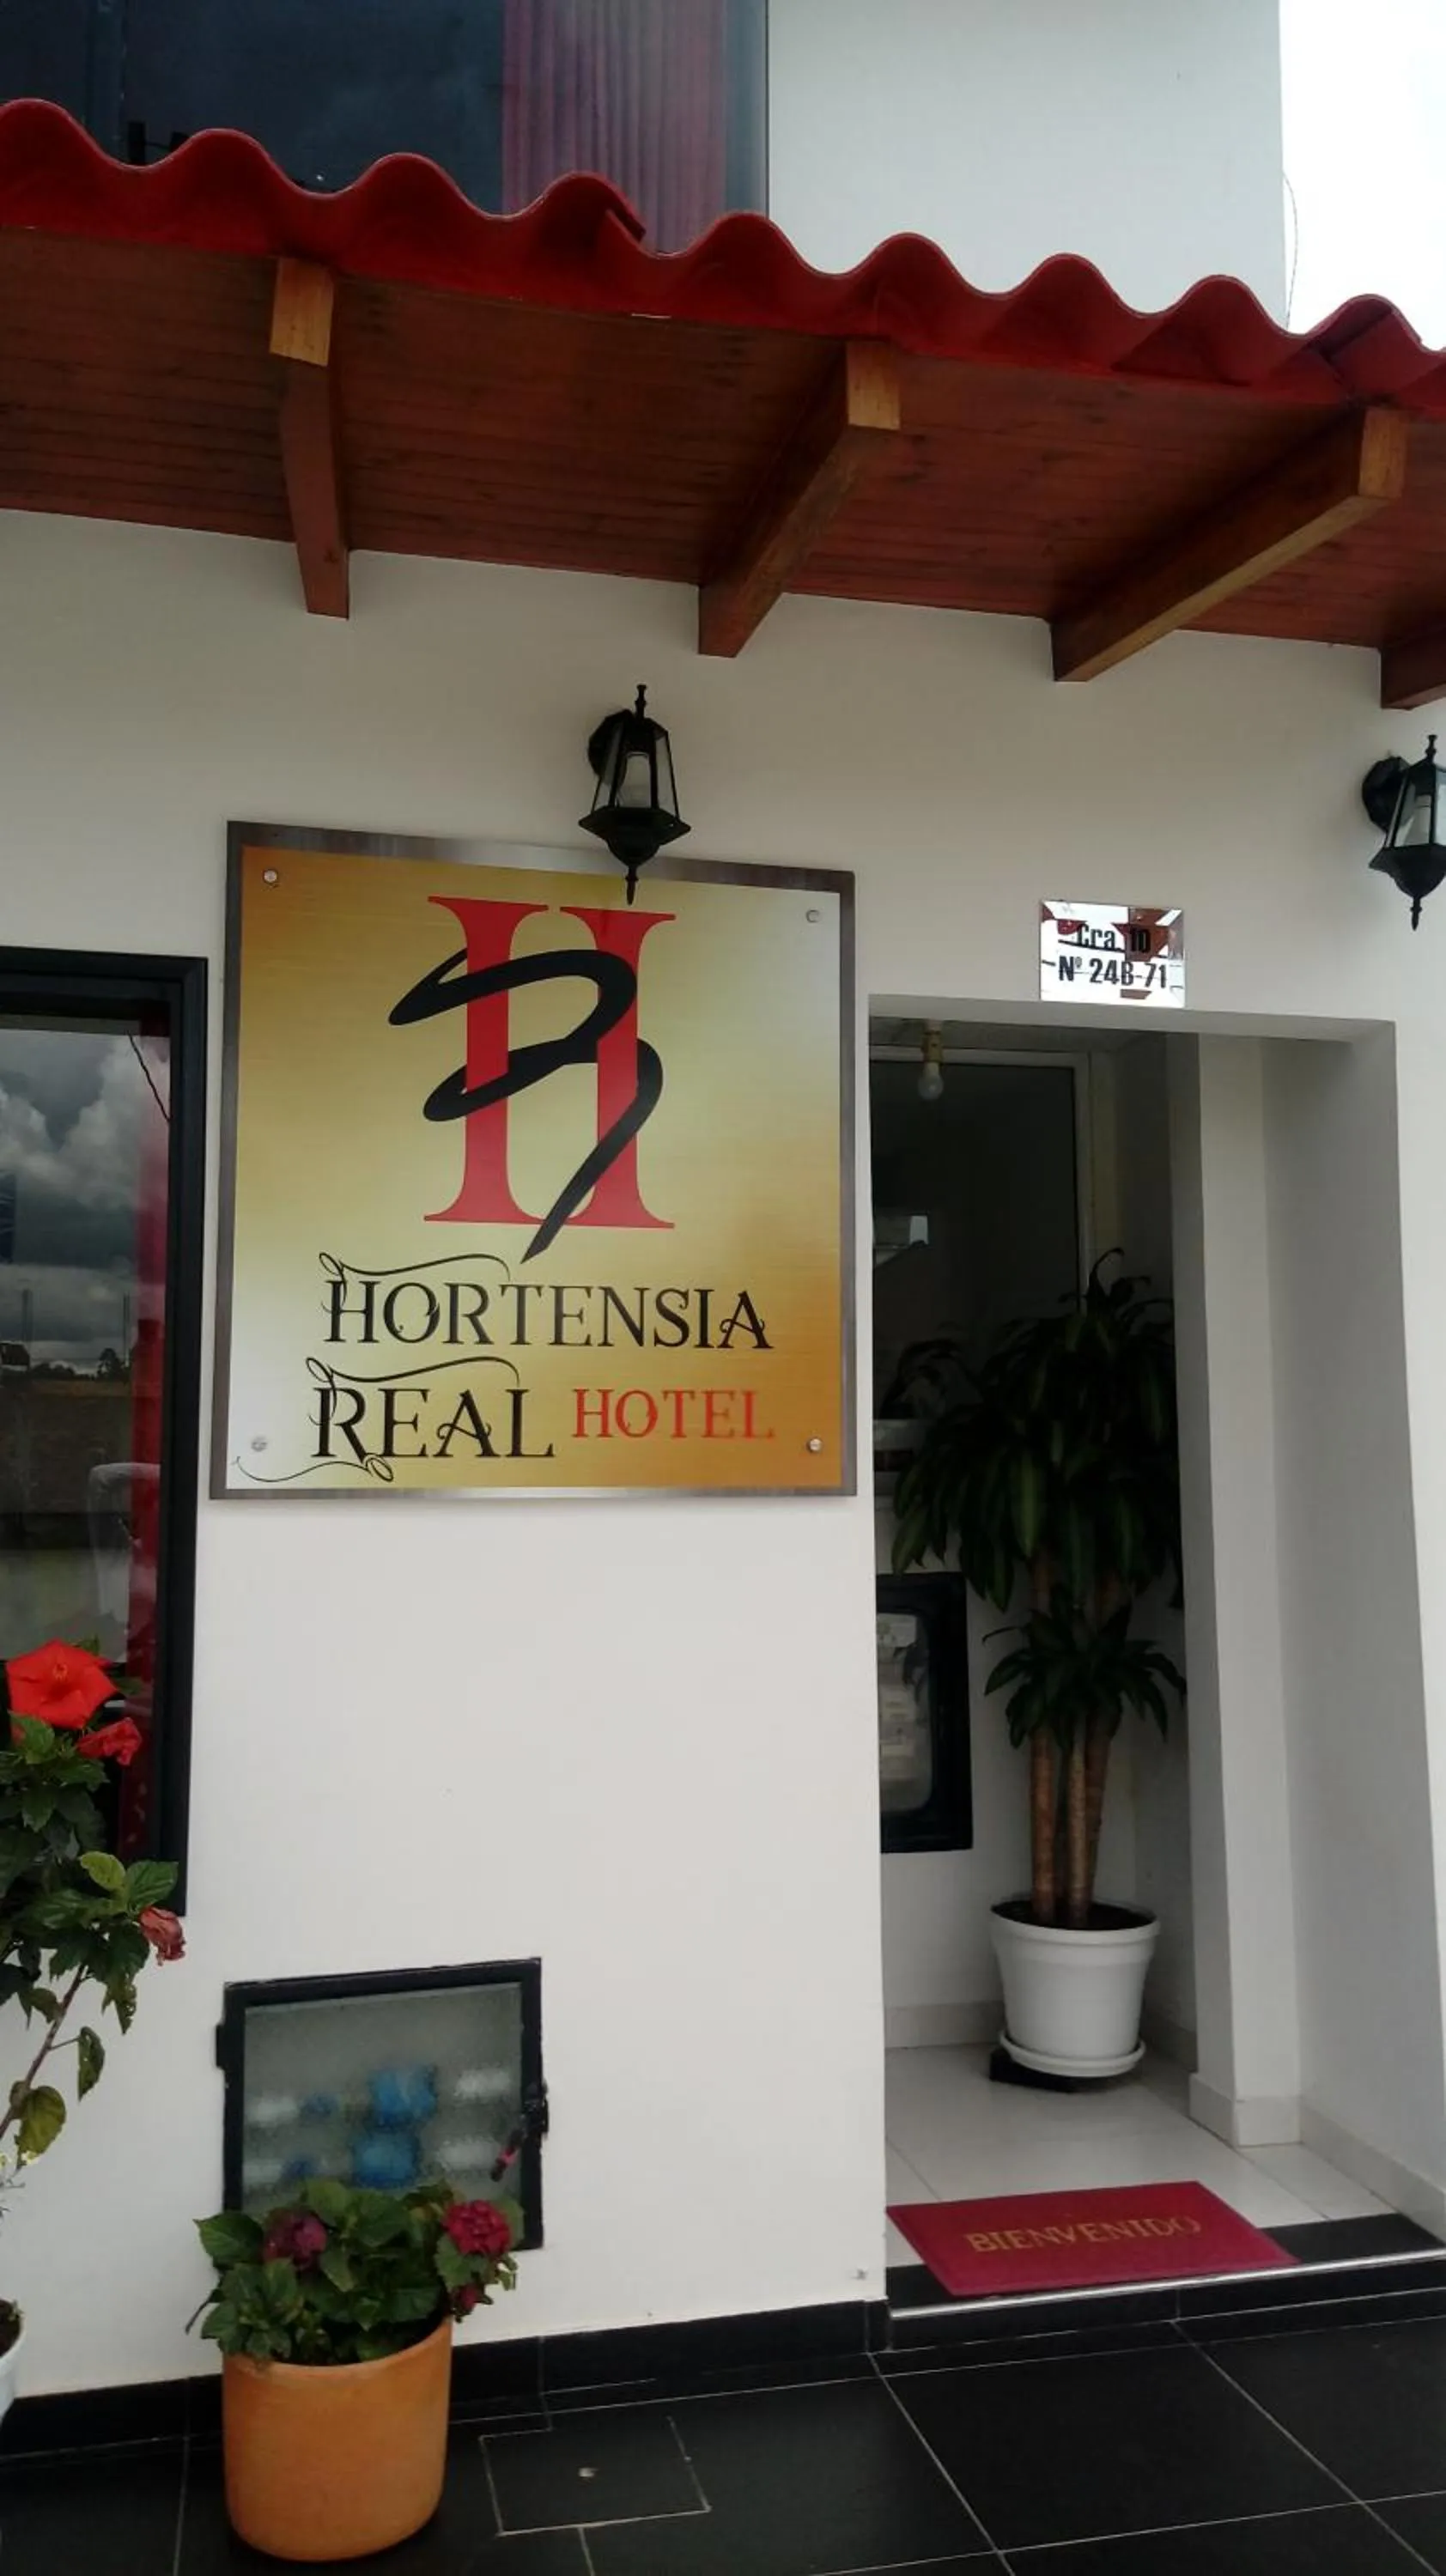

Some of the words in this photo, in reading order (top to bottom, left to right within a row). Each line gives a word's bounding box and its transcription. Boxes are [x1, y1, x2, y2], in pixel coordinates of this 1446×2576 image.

[1077, 922, 1116, 950] Cra
[320, 1267, 774, 1351] HORTENSIA
[306, 1374, 556, 1477] REAL
[571, 1388, 775, 1440] HOTEL
[965, 2215, 1202, 2252] BIENVENIDO
